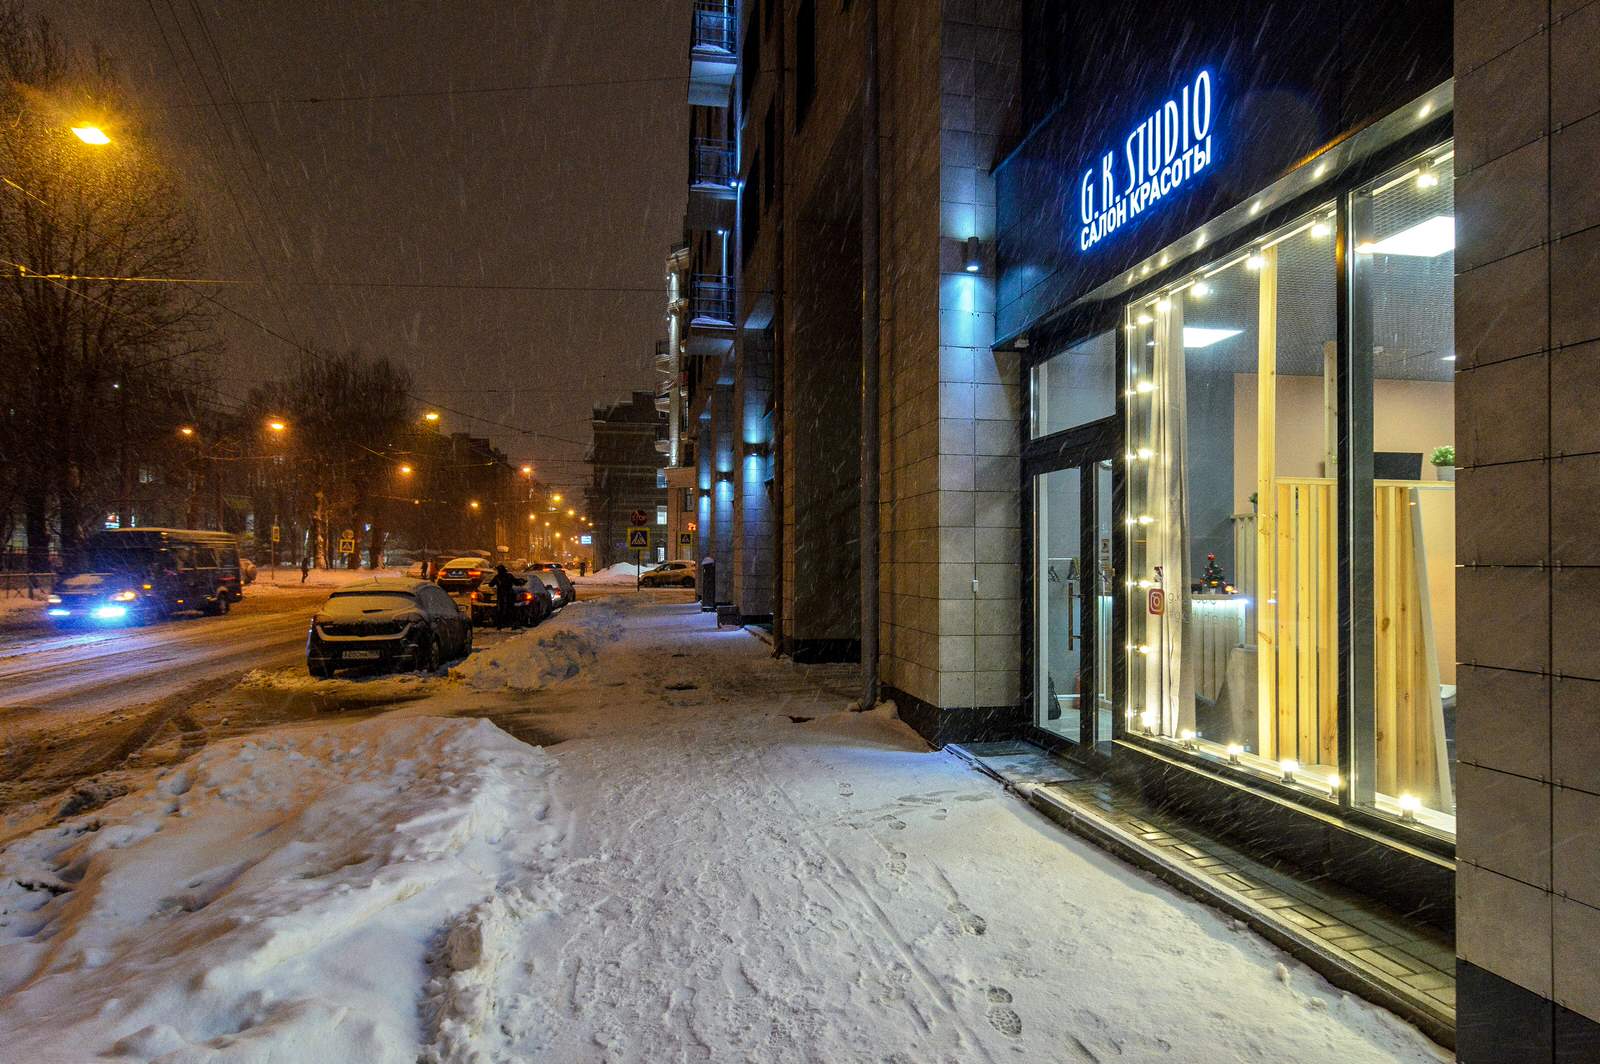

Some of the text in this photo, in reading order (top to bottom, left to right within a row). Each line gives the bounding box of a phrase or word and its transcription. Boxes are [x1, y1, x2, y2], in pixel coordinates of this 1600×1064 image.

[1081, 134, 1211, 250] САЛОН КРАСОТЫ
[1125, 70, 1211, 195] STUDIO
